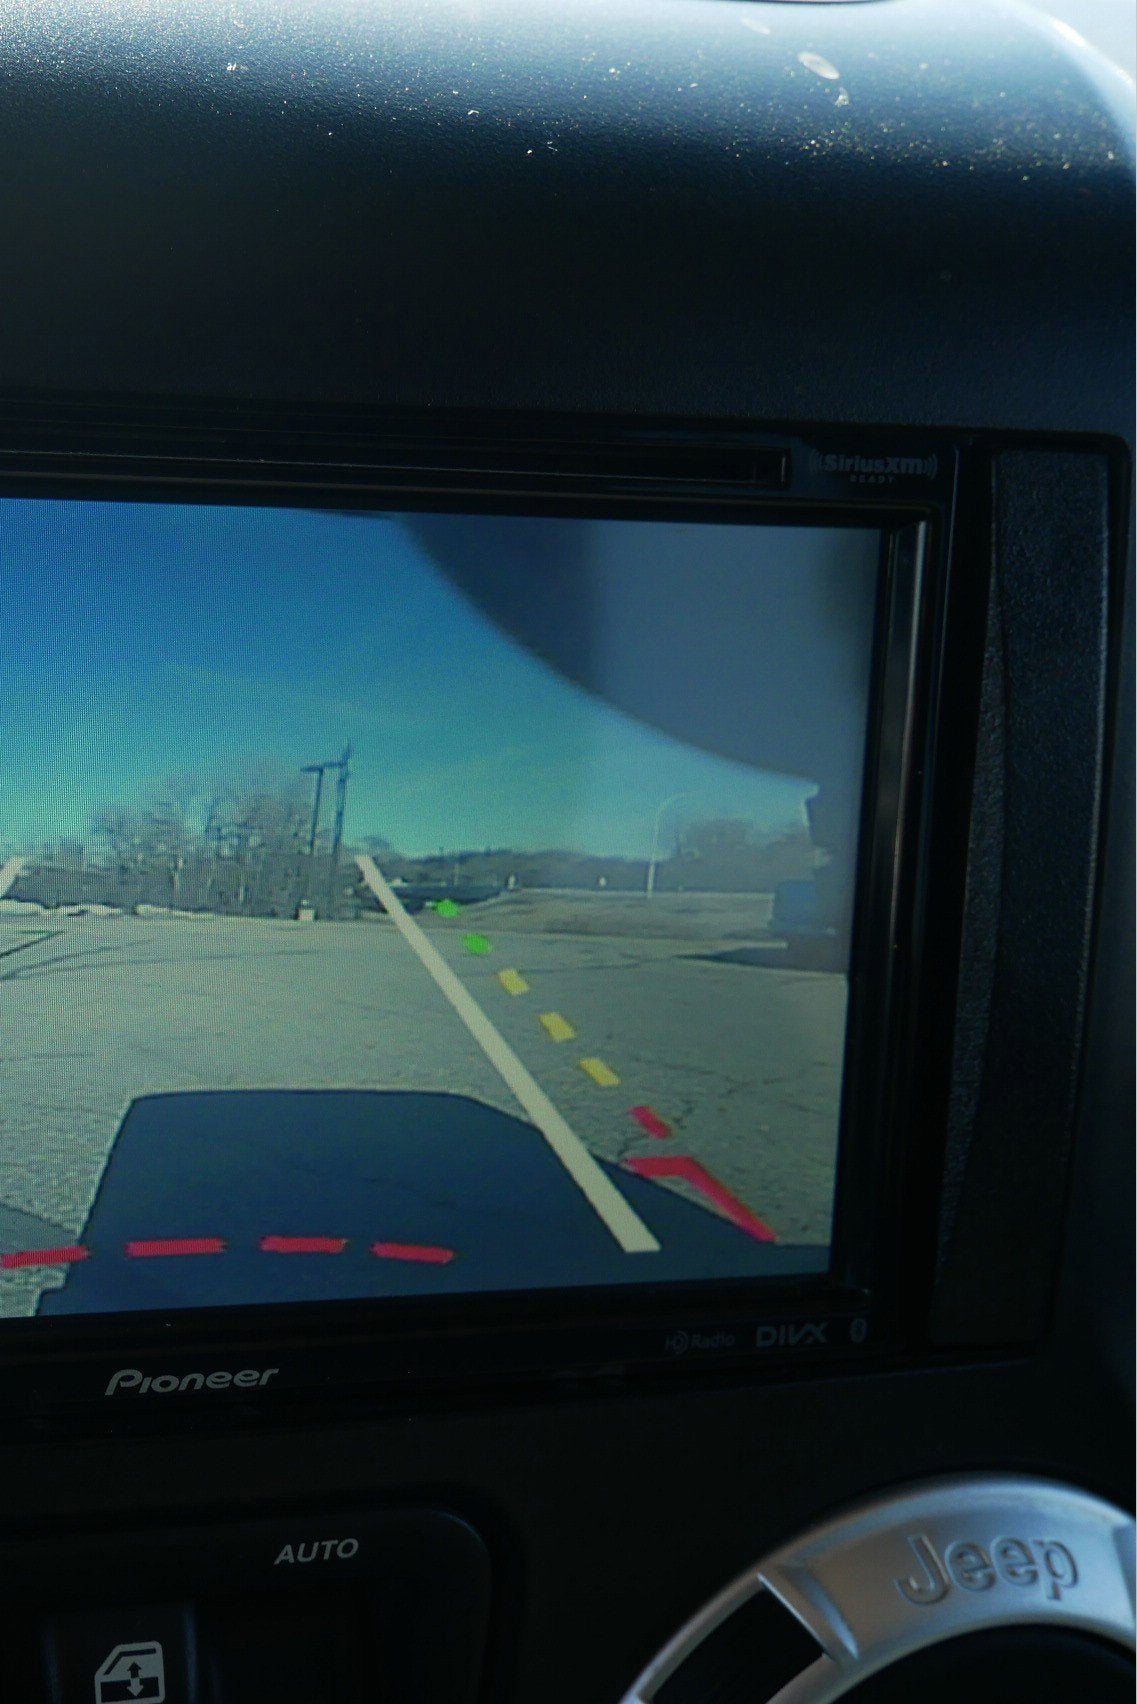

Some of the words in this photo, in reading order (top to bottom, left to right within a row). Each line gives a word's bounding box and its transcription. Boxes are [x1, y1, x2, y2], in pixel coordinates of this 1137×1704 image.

[690, 1329, 737, 1349] Radio
[104, 1367, 280, 1396] Pioneer
[275, 1537, 360, 1566] AUTO
[893, 1533, 1079, 1606] Jeep
